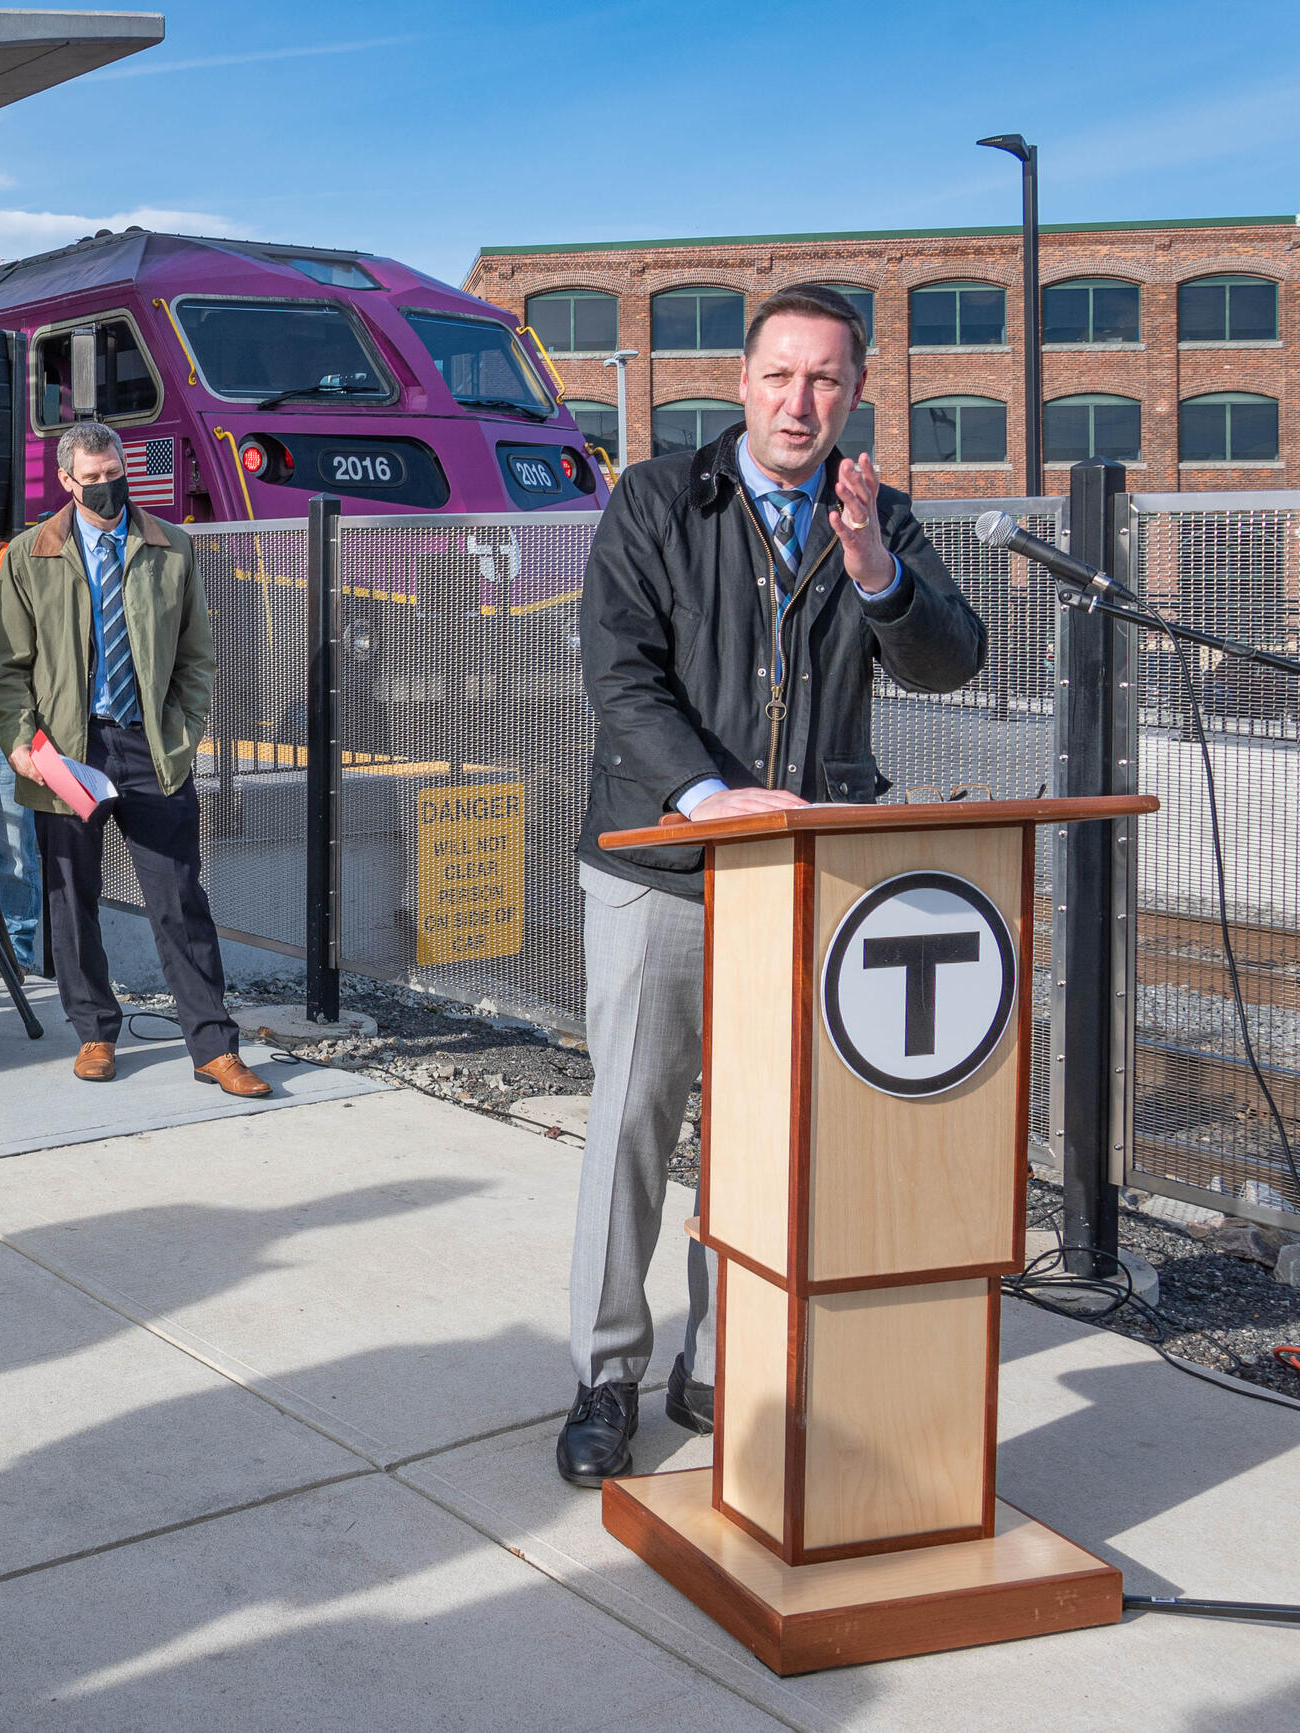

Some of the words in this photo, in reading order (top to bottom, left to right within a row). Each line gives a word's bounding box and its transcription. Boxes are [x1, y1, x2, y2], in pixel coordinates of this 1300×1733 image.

[333, 456, 391, 481] 2016
[516, 462, 552, 487] 2016
[421, 796, 520, 825] DANGER
[434, 839, 472, 857] WILL
[476, 836, 508, 853] NOT
[444, 861, 498, 881] CLEAR
[438, 883, 504, 905] PERSON
[424, 913, 448, 932] ON
[453, 909, 491, 929] SIDE
[495, 906, 516, 924] OF
[452, 934, 486, 953] CAR
[863, 931, 981, 1057] T
